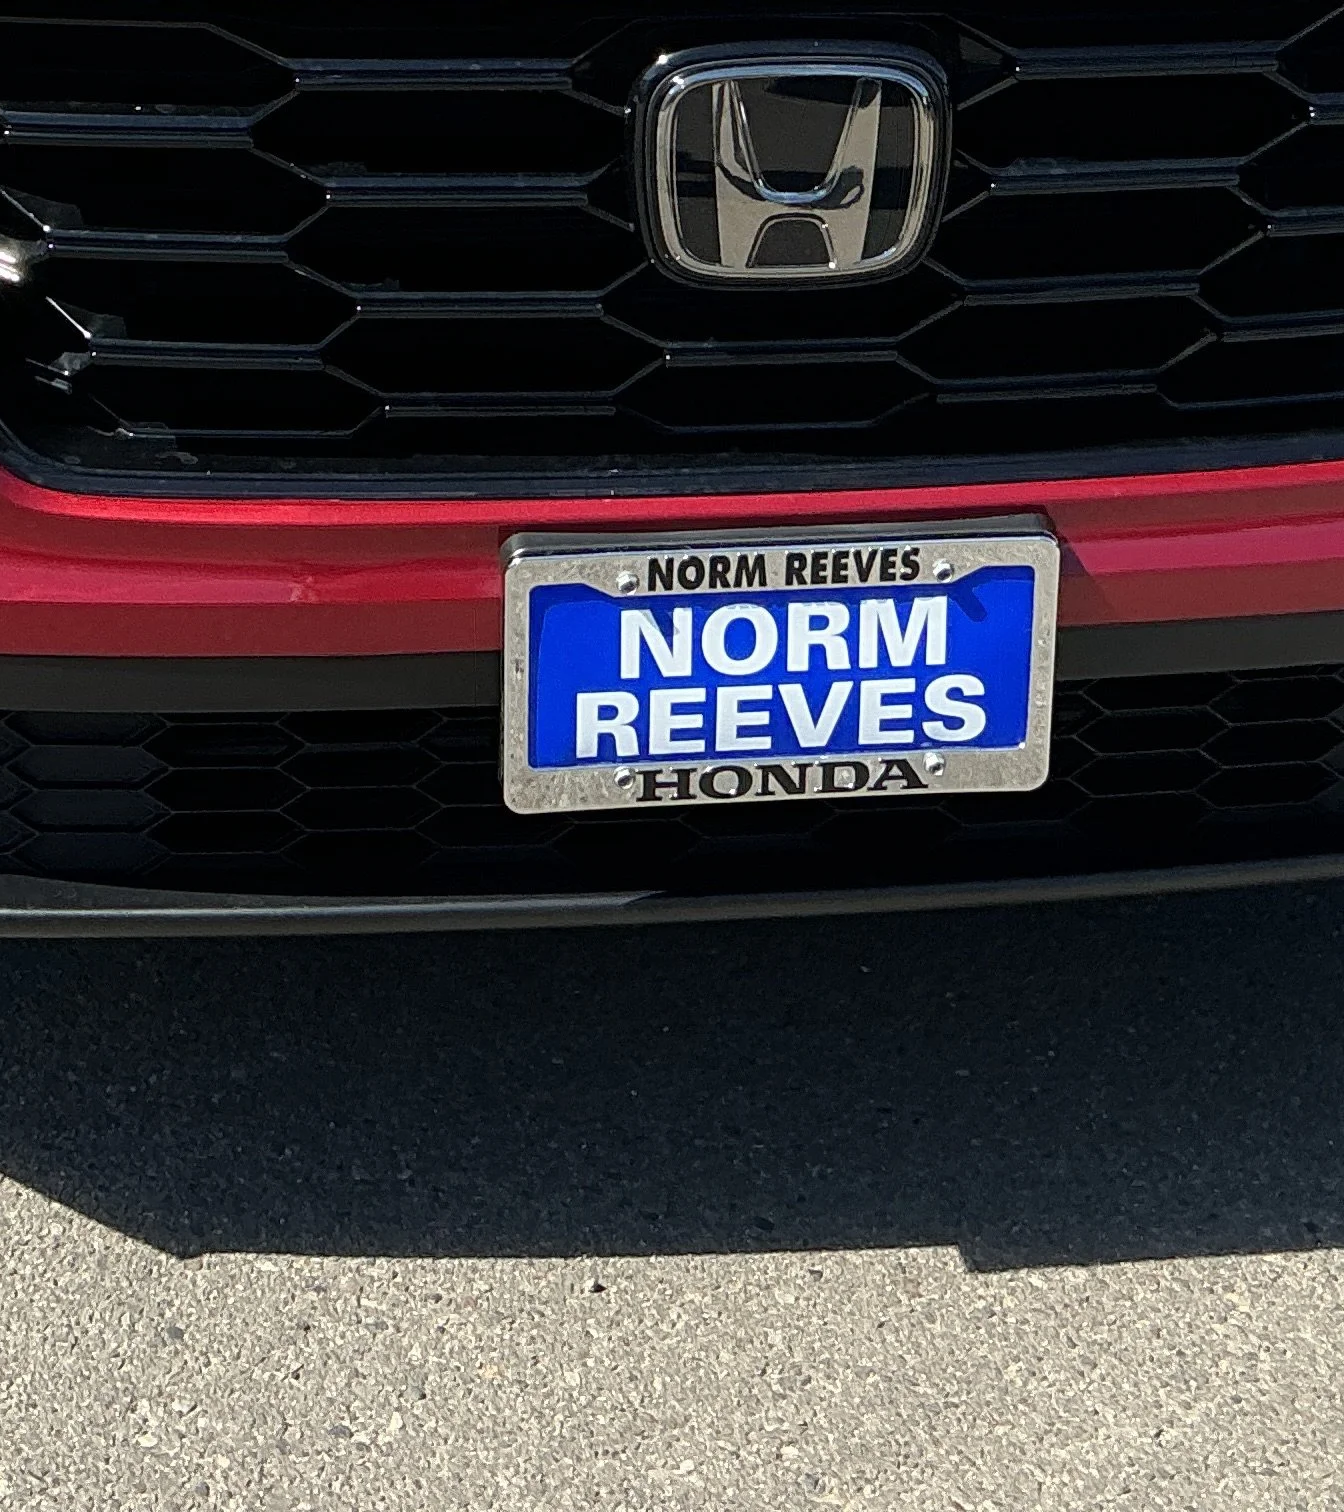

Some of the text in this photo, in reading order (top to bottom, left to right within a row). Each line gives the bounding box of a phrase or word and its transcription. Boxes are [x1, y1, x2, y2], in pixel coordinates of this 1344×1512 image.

[647, 548, 921, 591] NORM REEVES
[619, 595, 948, 679] NORM
[575, 674, 986, 759] REEVES
[635, 758, 929, 802] HONDA
